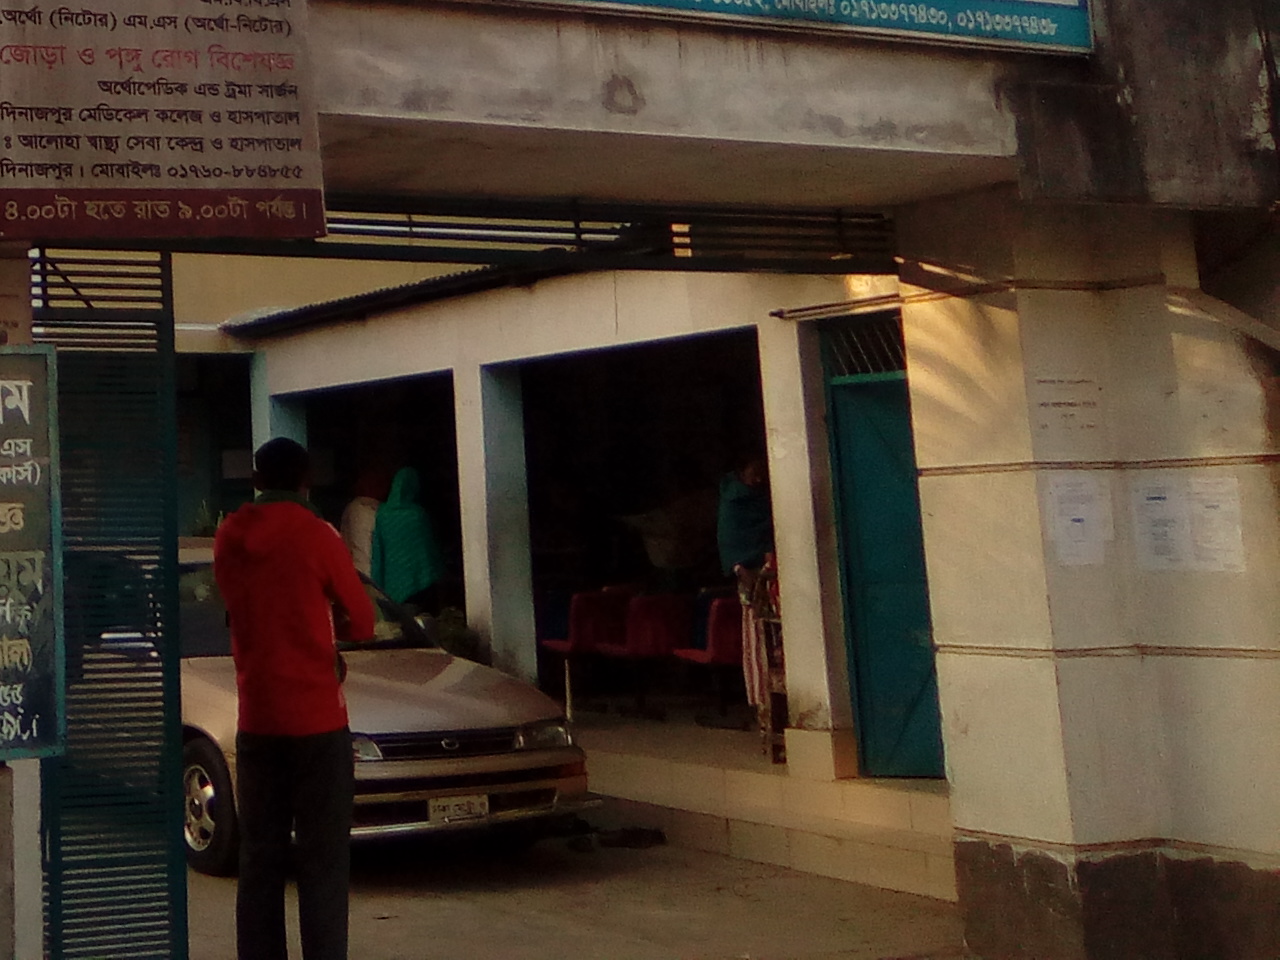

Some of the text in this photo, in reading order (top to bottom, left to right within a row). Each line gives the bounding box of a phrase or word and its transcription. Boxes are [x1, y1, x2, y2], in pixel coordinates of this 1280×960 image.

[49, 7, 117, 31] (নিটোর)
[124, 14, 178, 30] এম.এস
[0, 44, 67, 70] জোড়া
[77, 48, 95, 65] ও
[105, 46, 144, 73] পঙ্গু
[152, 48, 200, 69] রোগ
[207, 44, 295, 72] বিশেষজ্ঞ
[0, 101, 300, 126] দিনাজপুর মেডিকেল কলেজ ও হাসপাতাল
[18, 134, 82, 150] আলোহা
[126, 136, 161, 150] সেবা
[212, 139, 223, 150] ও
[228, 137, 302, 152] হাসপাতাল
[5, 195, 77, 221] ৪.০০টা
[84, 199, 125, 220] হতে
[133, 199, 170, 220] রাত
[178, 197, 249, 220] ৯.০০টা
